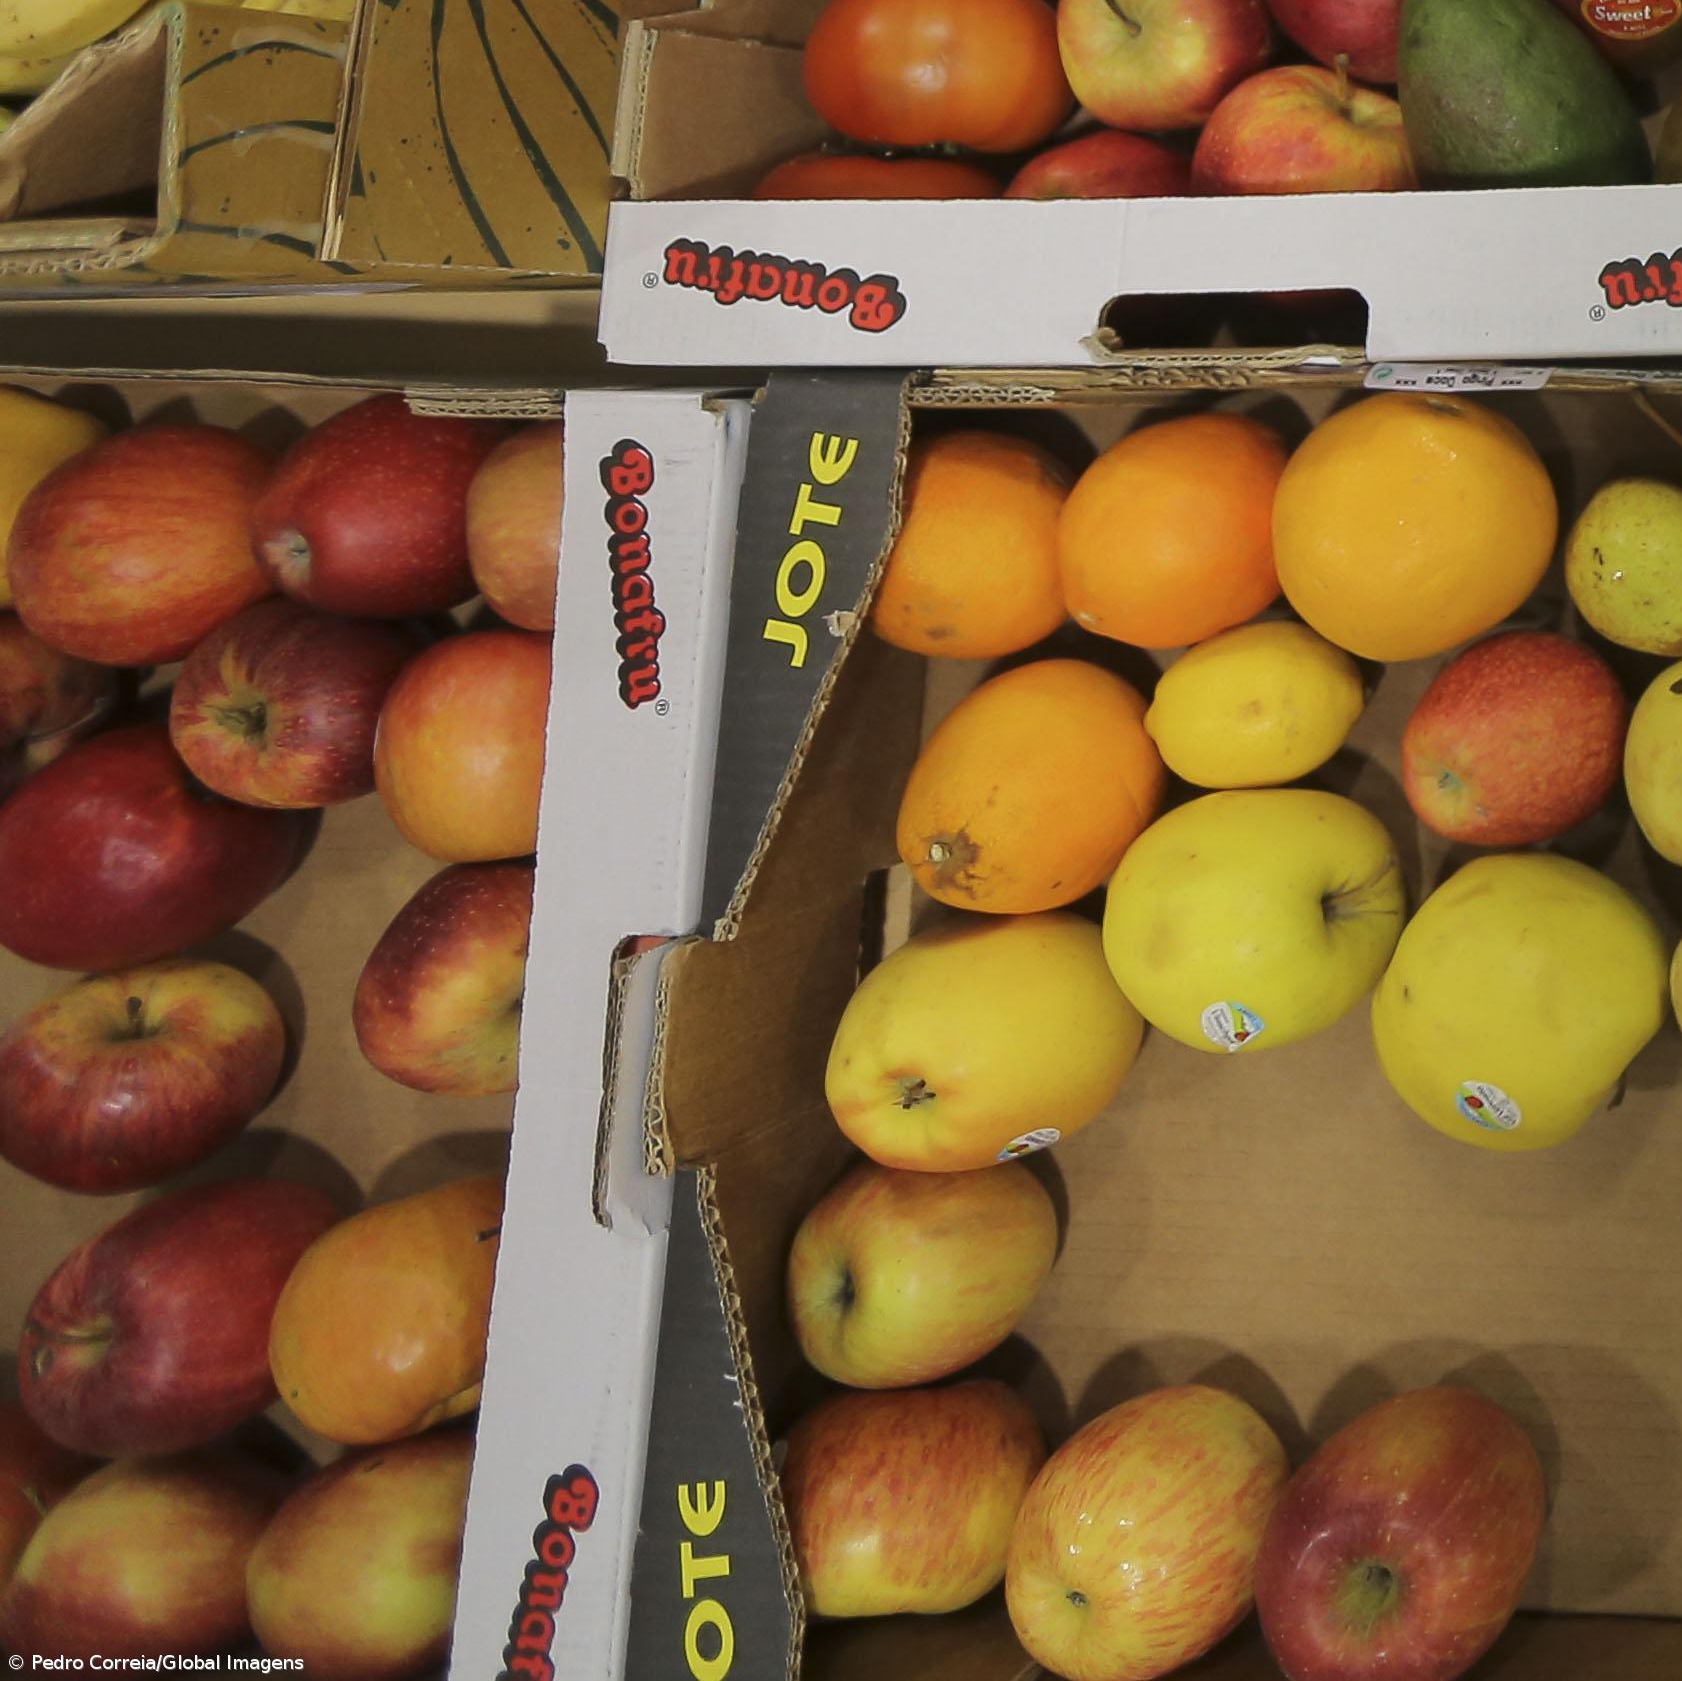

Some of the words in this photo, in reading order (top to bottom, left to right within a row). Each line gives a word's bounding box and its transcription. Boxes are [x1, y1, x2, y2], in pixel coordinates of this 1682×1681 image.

[1593, 5, 1653, 22] Sweet
[662, 235, 909, 333] Bonafru
[1425, 374, 1456, 388] Doce
[1461, 372, 1495, 388] Pingo
[600, 437, 666, 709] Bonafru
[763, 431, 859, 669] JOTE
[677, 1479, 735, 1681] OTE
